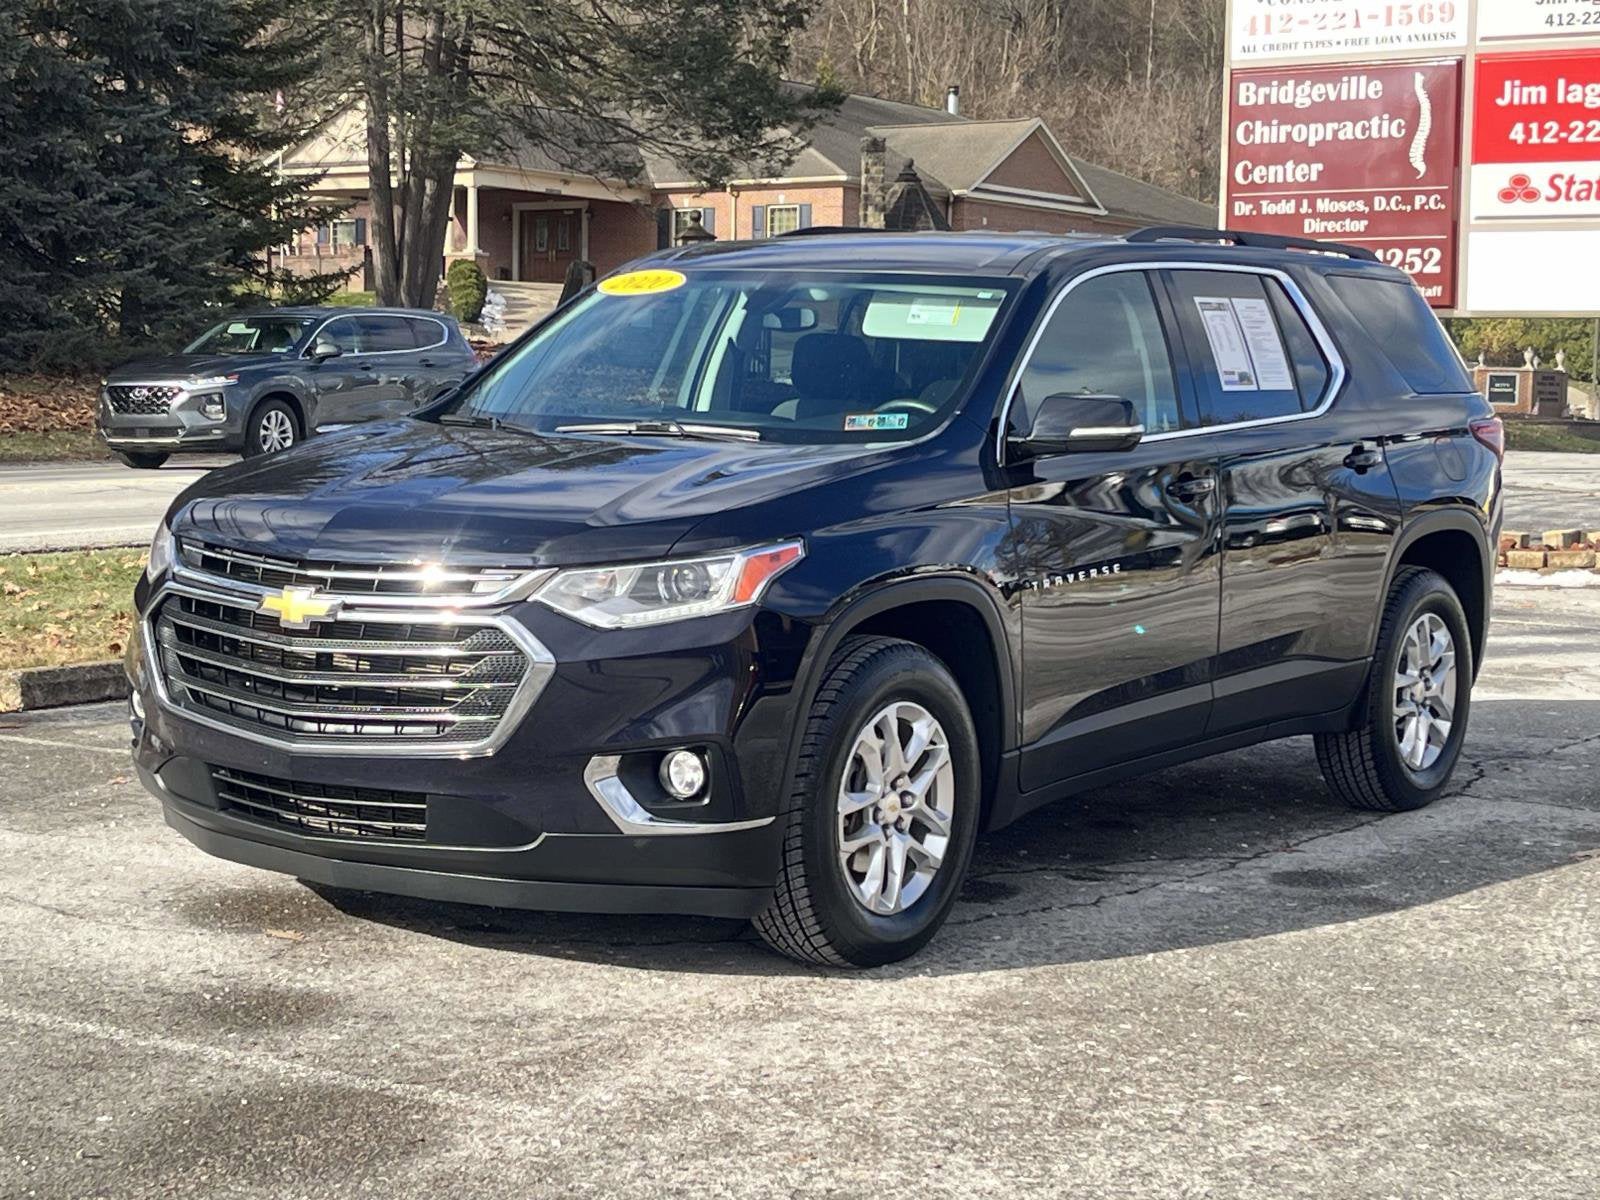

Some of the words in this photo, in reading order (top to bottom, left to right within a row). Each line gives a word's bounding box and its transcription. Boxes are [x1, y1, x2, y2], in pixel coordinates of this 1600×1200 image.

[1240, 45, 1257, 54] ALL
[1262, 41, 1298, 52] CREDIT
[1303, 40, 1334, 50] TYPES
[1344, 37, 1370, 47] FREE
[1375, 34, 1402, 44] LOAN
[1406, 31, 1457, 43] ANALYSIS
[1238, 75, 1383, 109] Bridgeville
[1495, 79, 1547, 106] Jim
[1235, 113, 1406, 147] Chiropractic
[1509, 119, 1600, 145] 412-22
[1234, 160, 1324, 185] Center
[1234, 201, 1257, 216] Dr.
[1260, 199, 1296, 215] Todd
[1299, 198, 1312, 214] J.
[1316, 197, 1370, 213] Moses,
[1373, 195, 1412, 212] D.C.,
[1414, 194, 1446, 210] P.C.
[1303, 217, 1369, 234] Director
[1031, 563, 1121, 592] TRAVERSE
